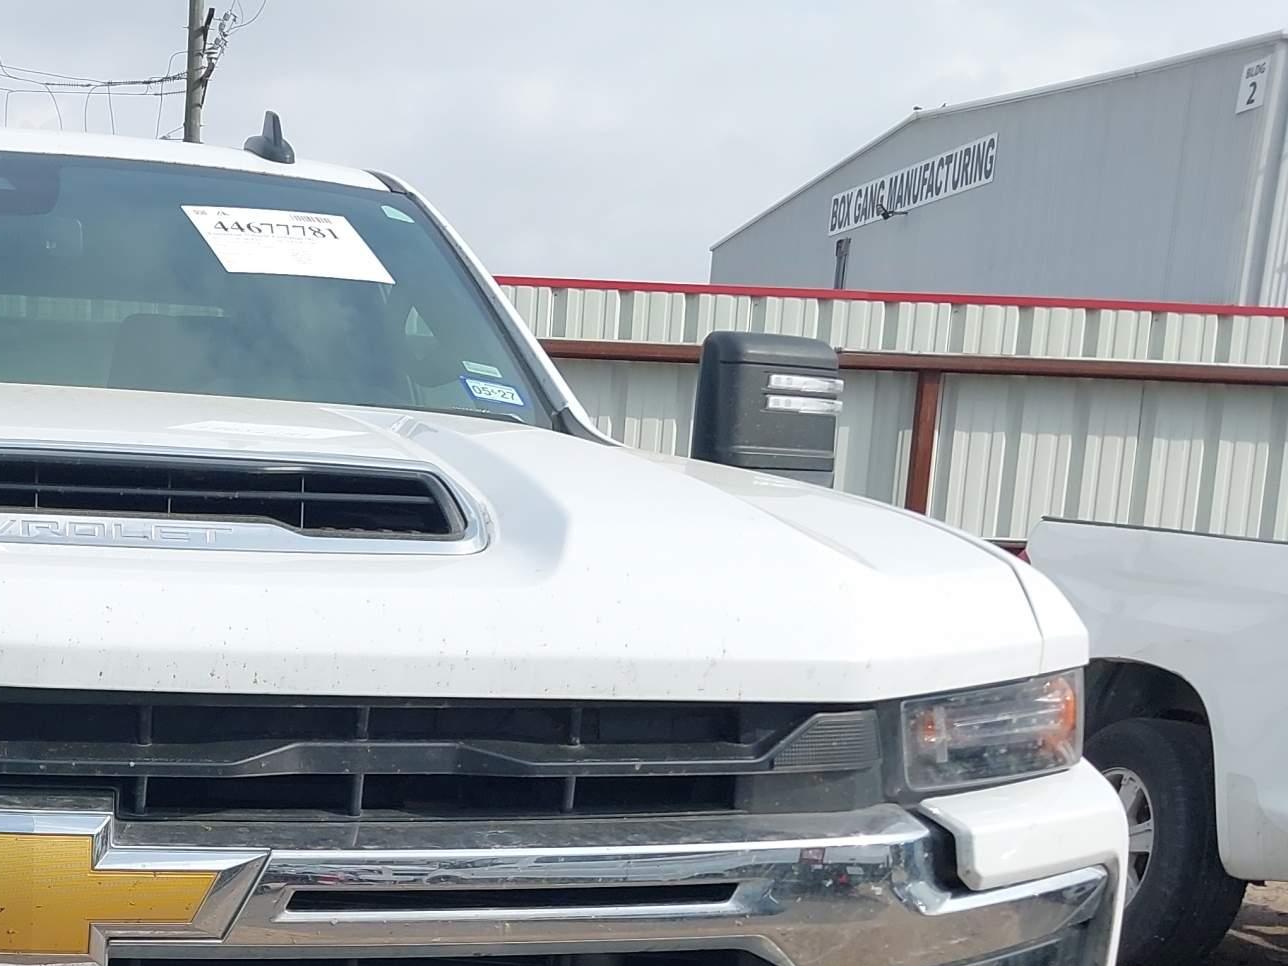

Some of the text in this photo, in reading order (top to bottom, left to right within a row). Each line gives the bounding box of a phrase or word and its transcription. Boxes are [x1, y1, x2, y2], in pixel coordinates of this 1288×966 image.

[1245, 61, 1266, 79] BLDG
[1246, 81, 1257, 105] 2
[830, 137, 995, 231] BOX GANG MANUFACTURING
[214, 220, 340, 240] 44677781
